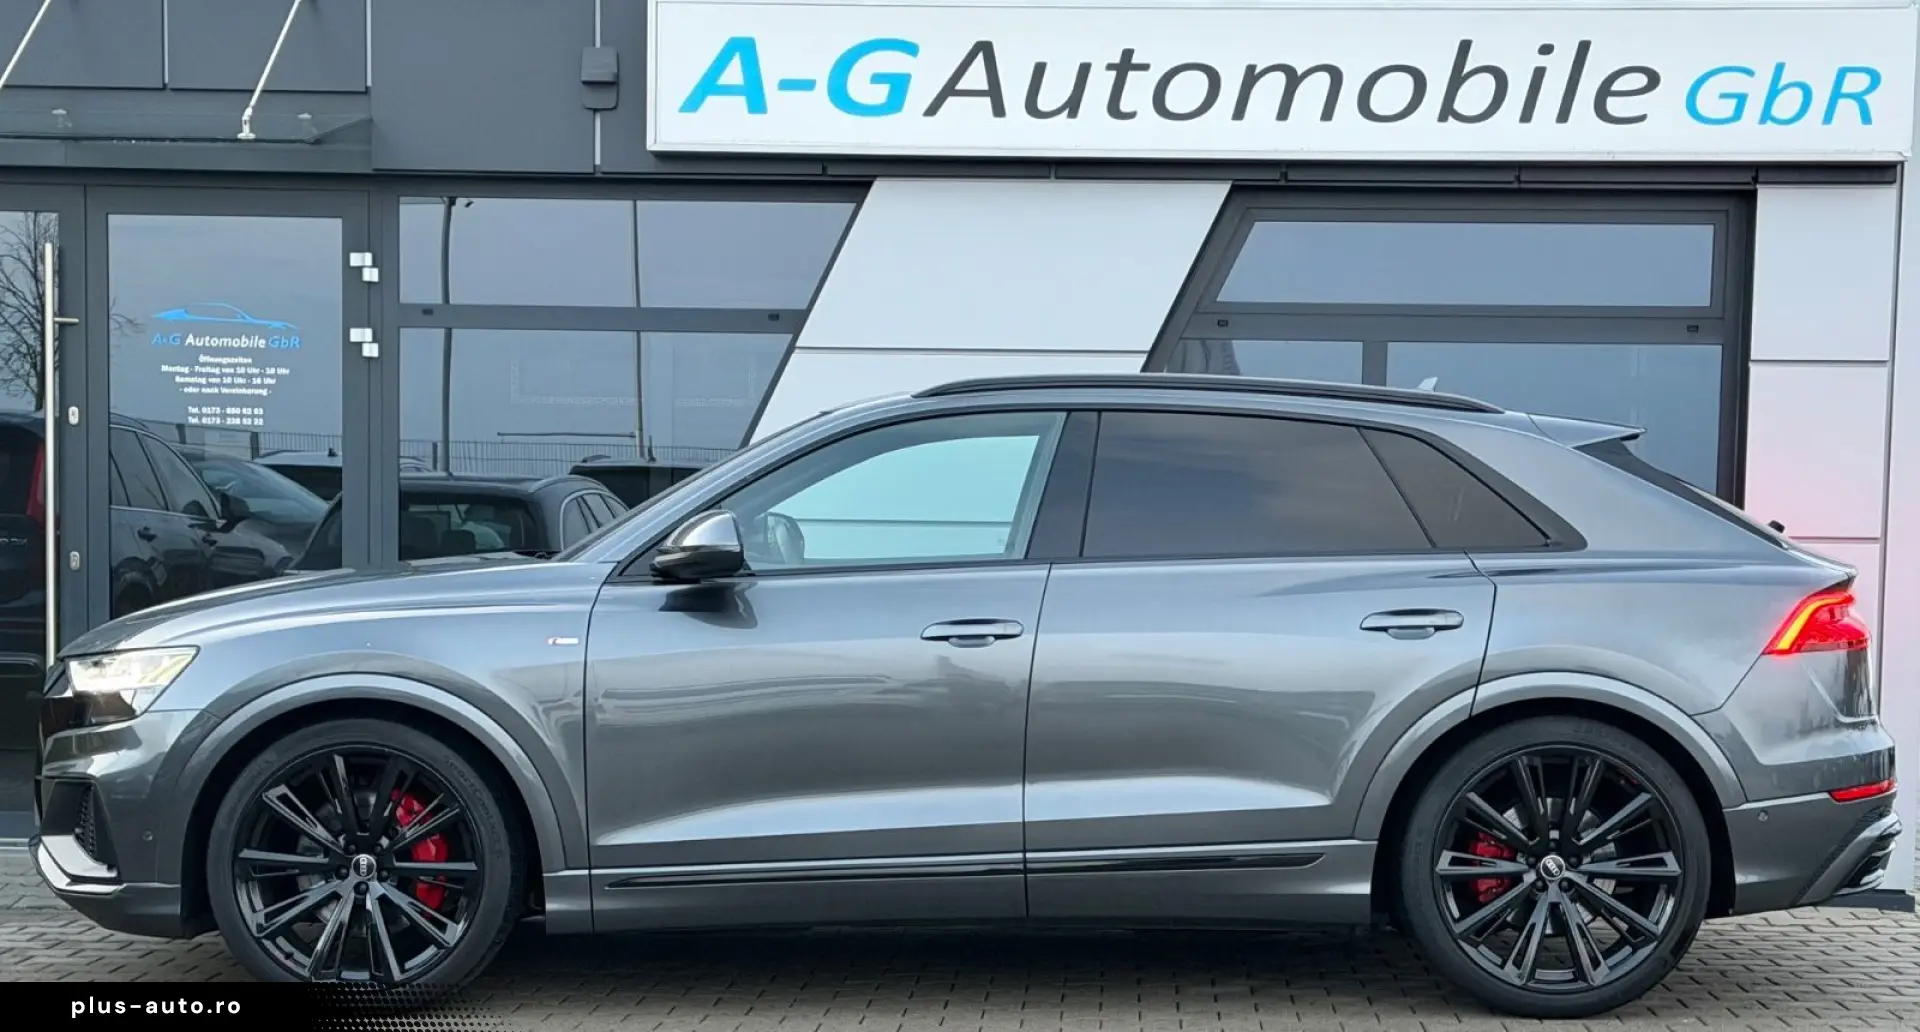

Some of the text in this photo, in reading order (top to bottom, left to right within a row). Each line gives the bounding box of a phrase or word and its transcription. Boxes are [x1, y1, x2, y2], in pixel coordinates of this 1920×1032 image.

[680, 37, 1882, 126] A-G Automobile GbR
[184, 333, 266, 349] Automobile
[268, 335, 301, 349] GbR
[198, 354, 253, 365] Öffnungszeiten
[161, 364, 189, 374] Montag
[194, 365, 221, 375] Freitag
[247, 366, 260, 375] Uhr
[276, 367, 290, 375] Uhr
[175, 375, 207, 385] Samstag
[233, 376, 246, 385] Uhr
[263, 377, 276, 385] Uhr
[201, 386, 219, 394] nach
[187, 406, 200, 414] Tel.
[187, 416, 200, 424] Tel.
